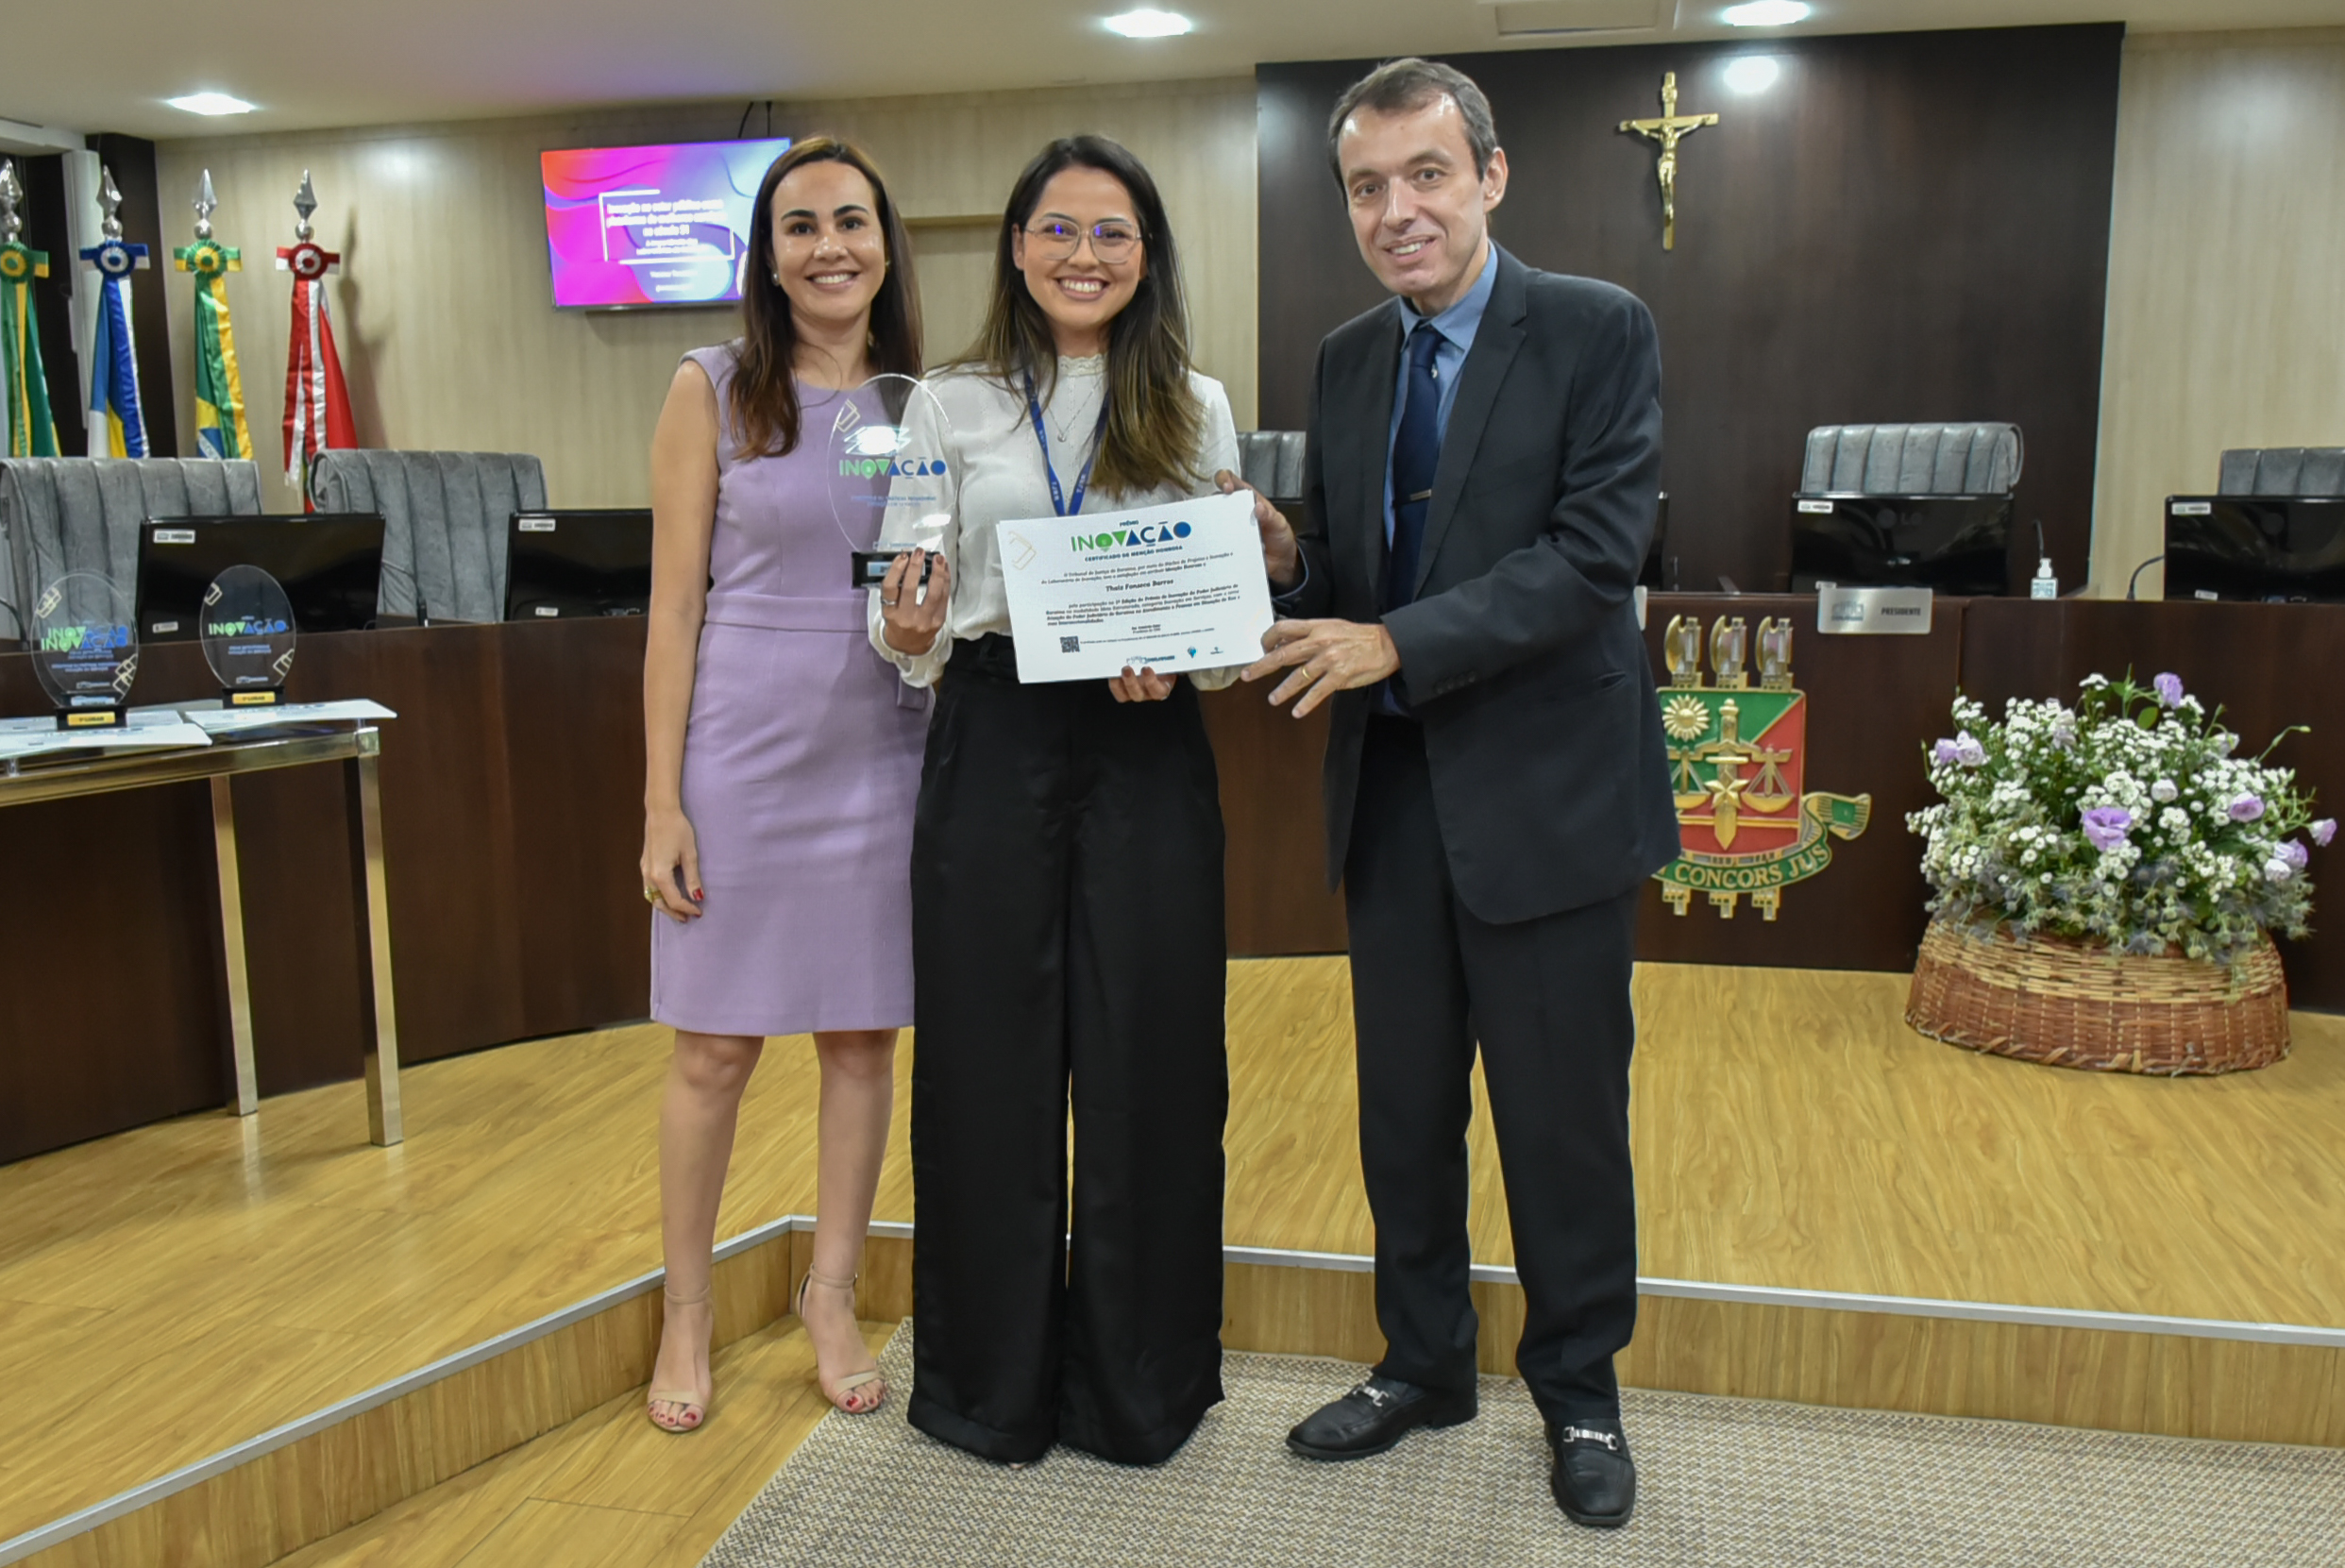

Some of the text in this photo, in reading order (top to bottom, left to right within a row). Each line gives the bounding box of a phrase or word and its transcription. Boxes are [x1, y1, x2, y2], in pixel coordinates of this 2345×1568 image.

[839, 457, 947, 480] INOVAÇÃO
[1071, 521, 1191, 552] INOVAÇÃO
[1124, 581, 1150, 589] Fonseca
[1152, 578, 1173, 586] Barros
[209, 618, 286, 636] INOVAÇÃO
[1675, 844, 1829, 888] CONCORS JUS
